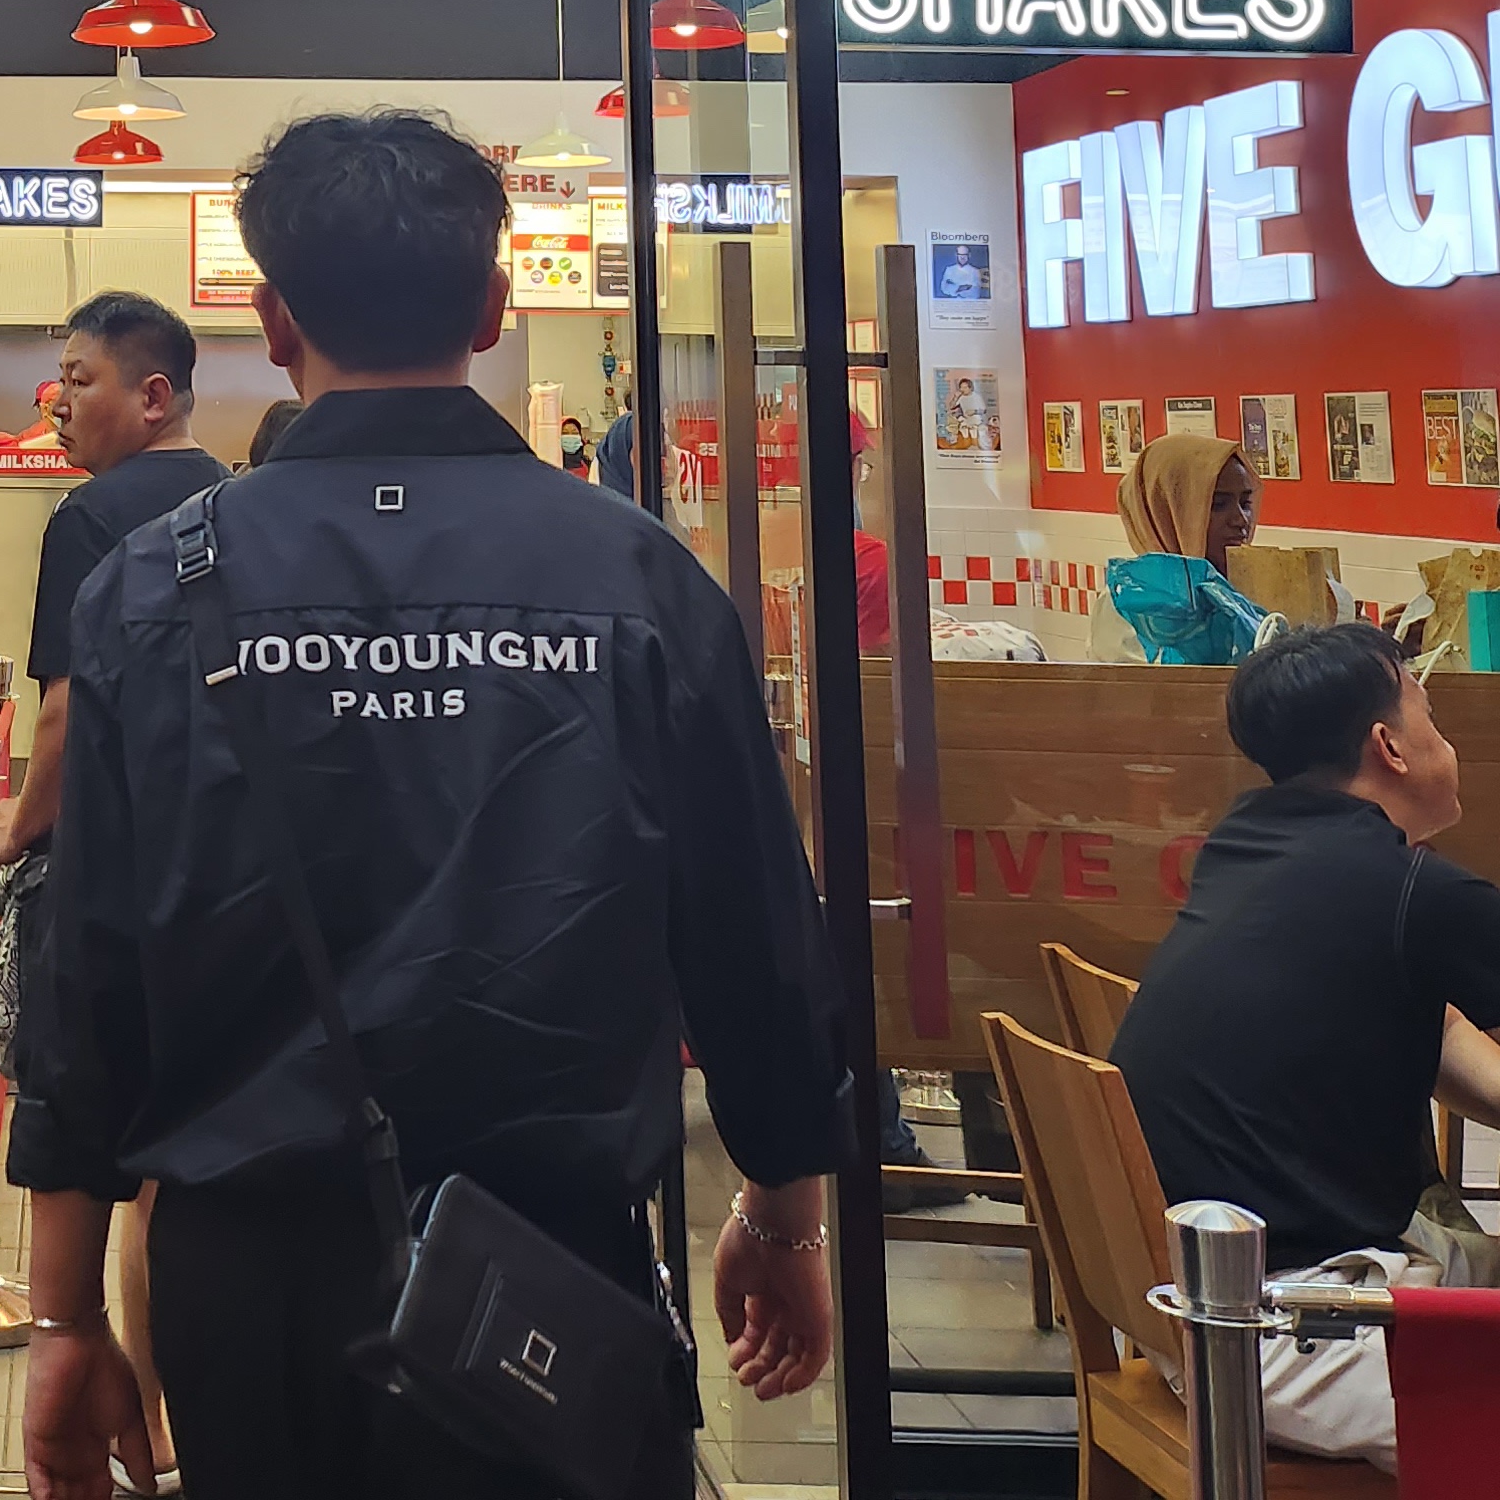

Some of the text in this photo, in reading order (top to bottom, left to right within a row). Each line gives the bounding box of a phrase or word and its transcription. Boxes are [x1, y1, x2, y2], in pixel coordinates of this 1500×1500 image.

[505, 174, 557, 193] ERE
[1023, 9, 1500, 329] FIVE G
[930, 231, 990, 244] Bloomberg
[1425, 416, 1459, 440] BEST
[237, 630, 599, 676] OOYOUNGMI
[330, 689, 467, 720] PARIS
[894, 827, 1119, 899] IVE
